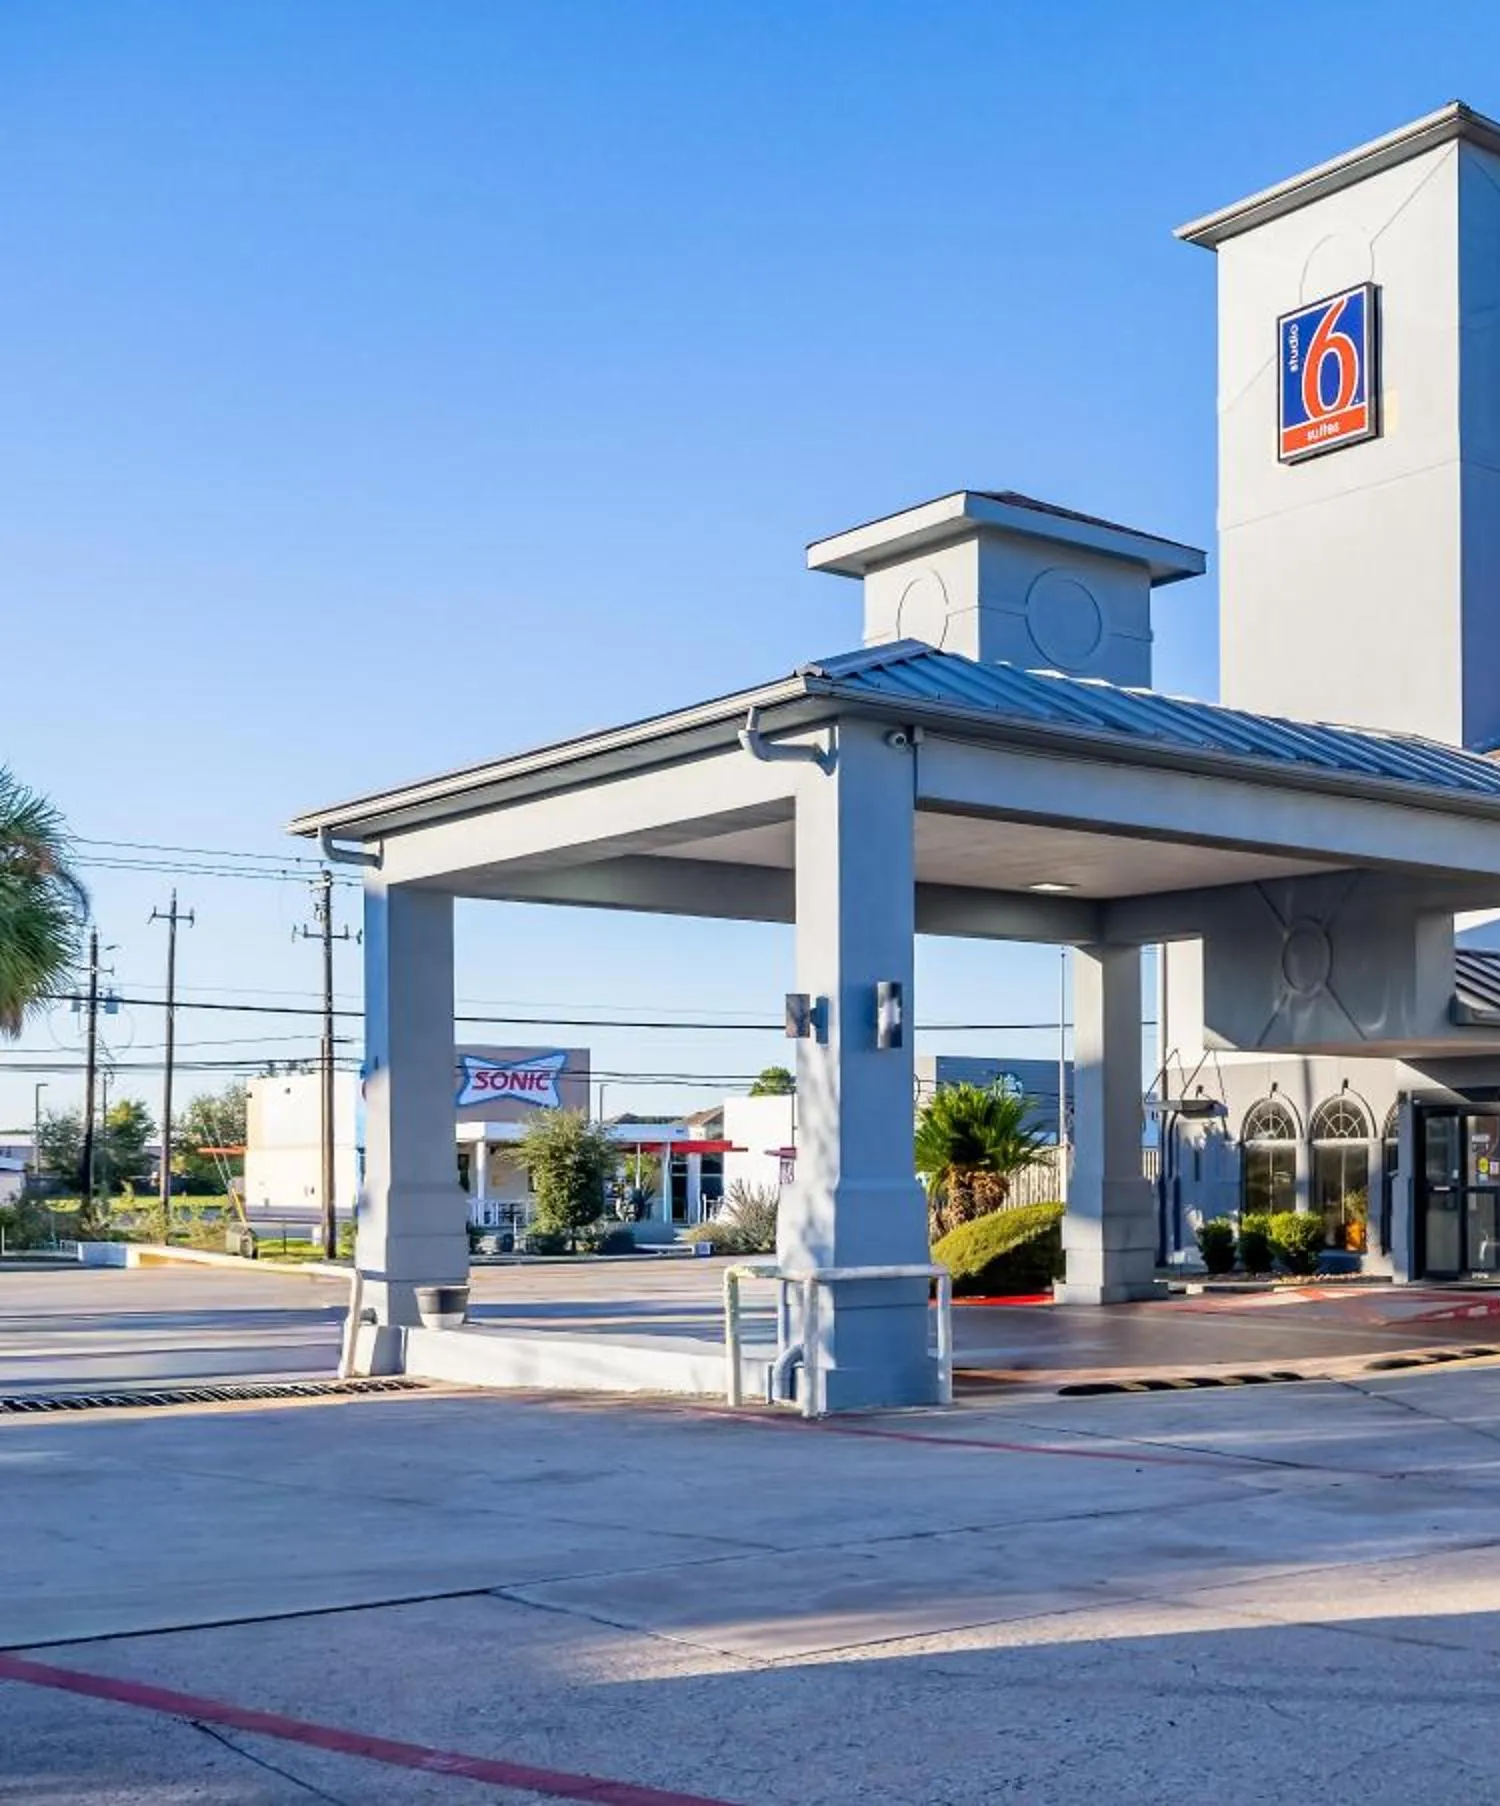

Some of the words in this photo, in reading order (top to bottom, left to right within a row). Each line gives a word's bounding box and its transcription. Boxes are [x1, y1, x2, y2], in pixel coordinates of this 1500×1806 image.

[1289, 323, 1299, 372] studio
[1301, 297, 1359, 420] 6
[1307, 421, 1340, 440] suites
[471, 1071, 550, 1091] SONIC
